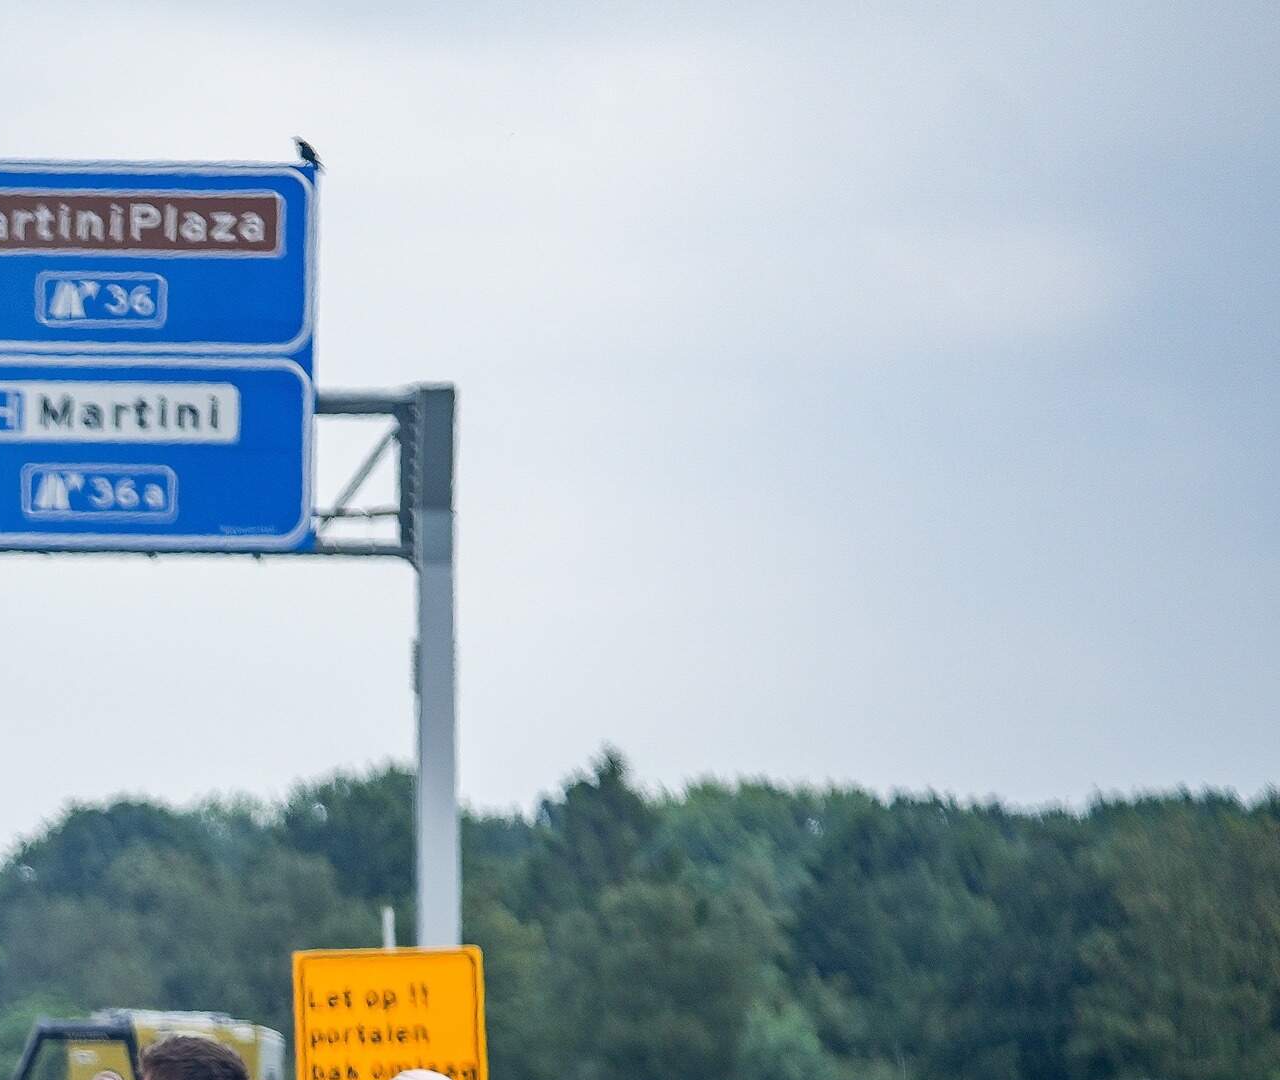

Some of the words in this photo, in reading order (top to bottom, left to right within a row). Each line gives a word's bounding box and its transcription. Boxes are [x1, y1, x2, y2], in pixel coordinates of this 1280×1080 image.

[105, 284, 156, 317] 36
[40, 395, 220, 432] Martini
[309, 986, 352, 1008] Let
[366, 990, 397, 1010] op
[311, 1024, 429, 1049] portalen
